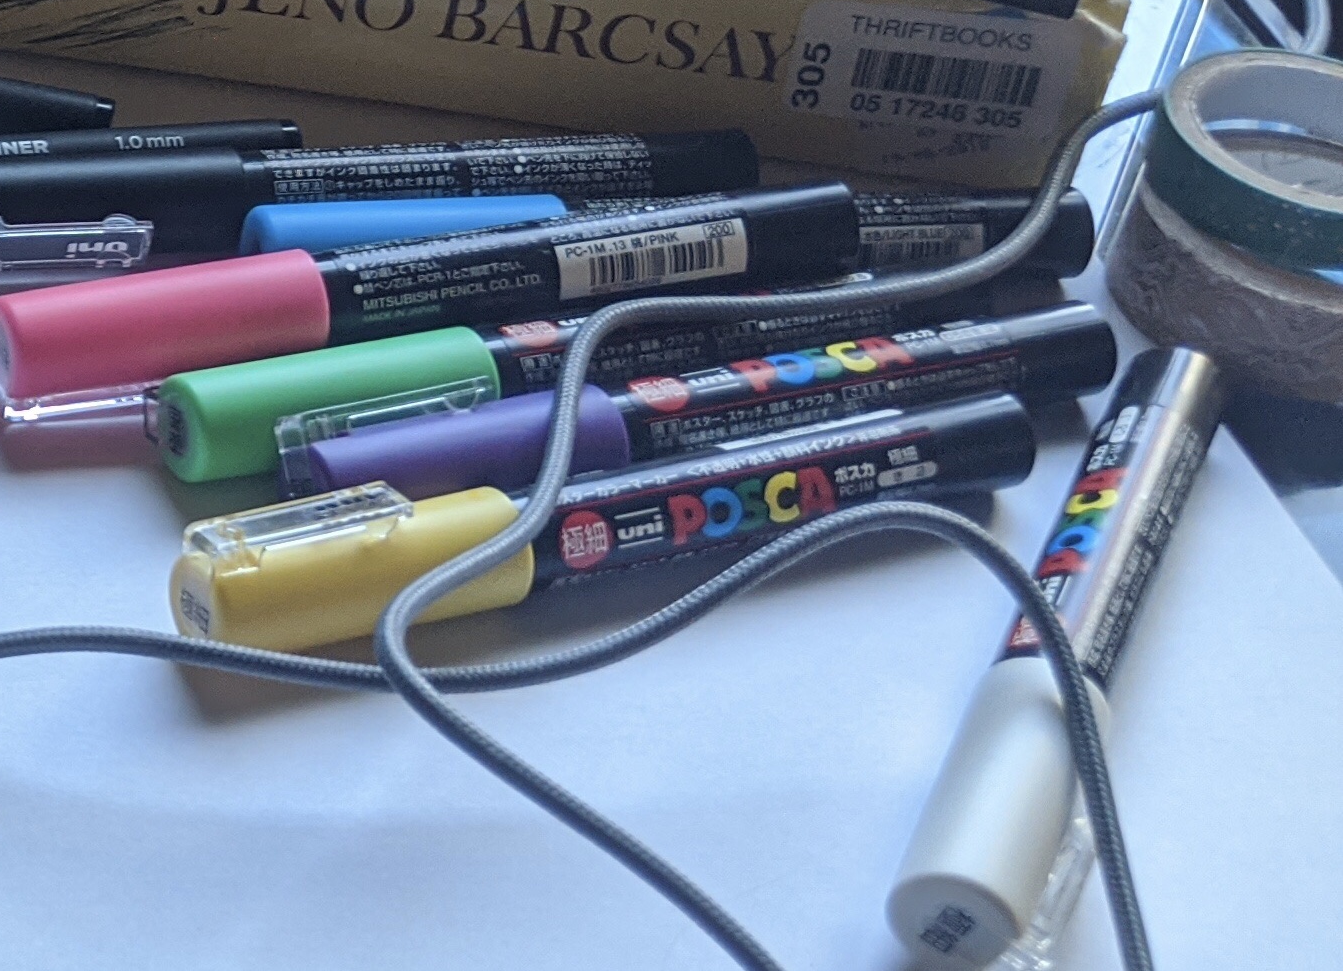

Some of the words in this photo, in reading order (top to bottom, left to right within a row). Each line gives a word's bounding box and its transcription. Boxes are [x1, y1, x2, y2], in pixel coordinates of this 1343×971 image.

[851, 14, 1032, 52] THRIFTBOOKS
[791, 42, 831, 110] 305
[850, 93, 881, 113] 05
[973, 107, 1023, 128] 305
[114, 133, 143, 151] 1.0
[146, 133, 185, 149] mm
[66, 241, 129, 258] uni
[364, 291, 438, 310] MITSUBISHI
[441, 283, 485, 297] PENCIL
[688, 370, 735, 386] uni
[730, 336, 914, 393] POSCA
[560, 520, 609, 558] 極細
[616, 515, 663, 542] uni
[667, 467, 837, 546] POSCA
[834, 463, 875, 482] ポスカ
